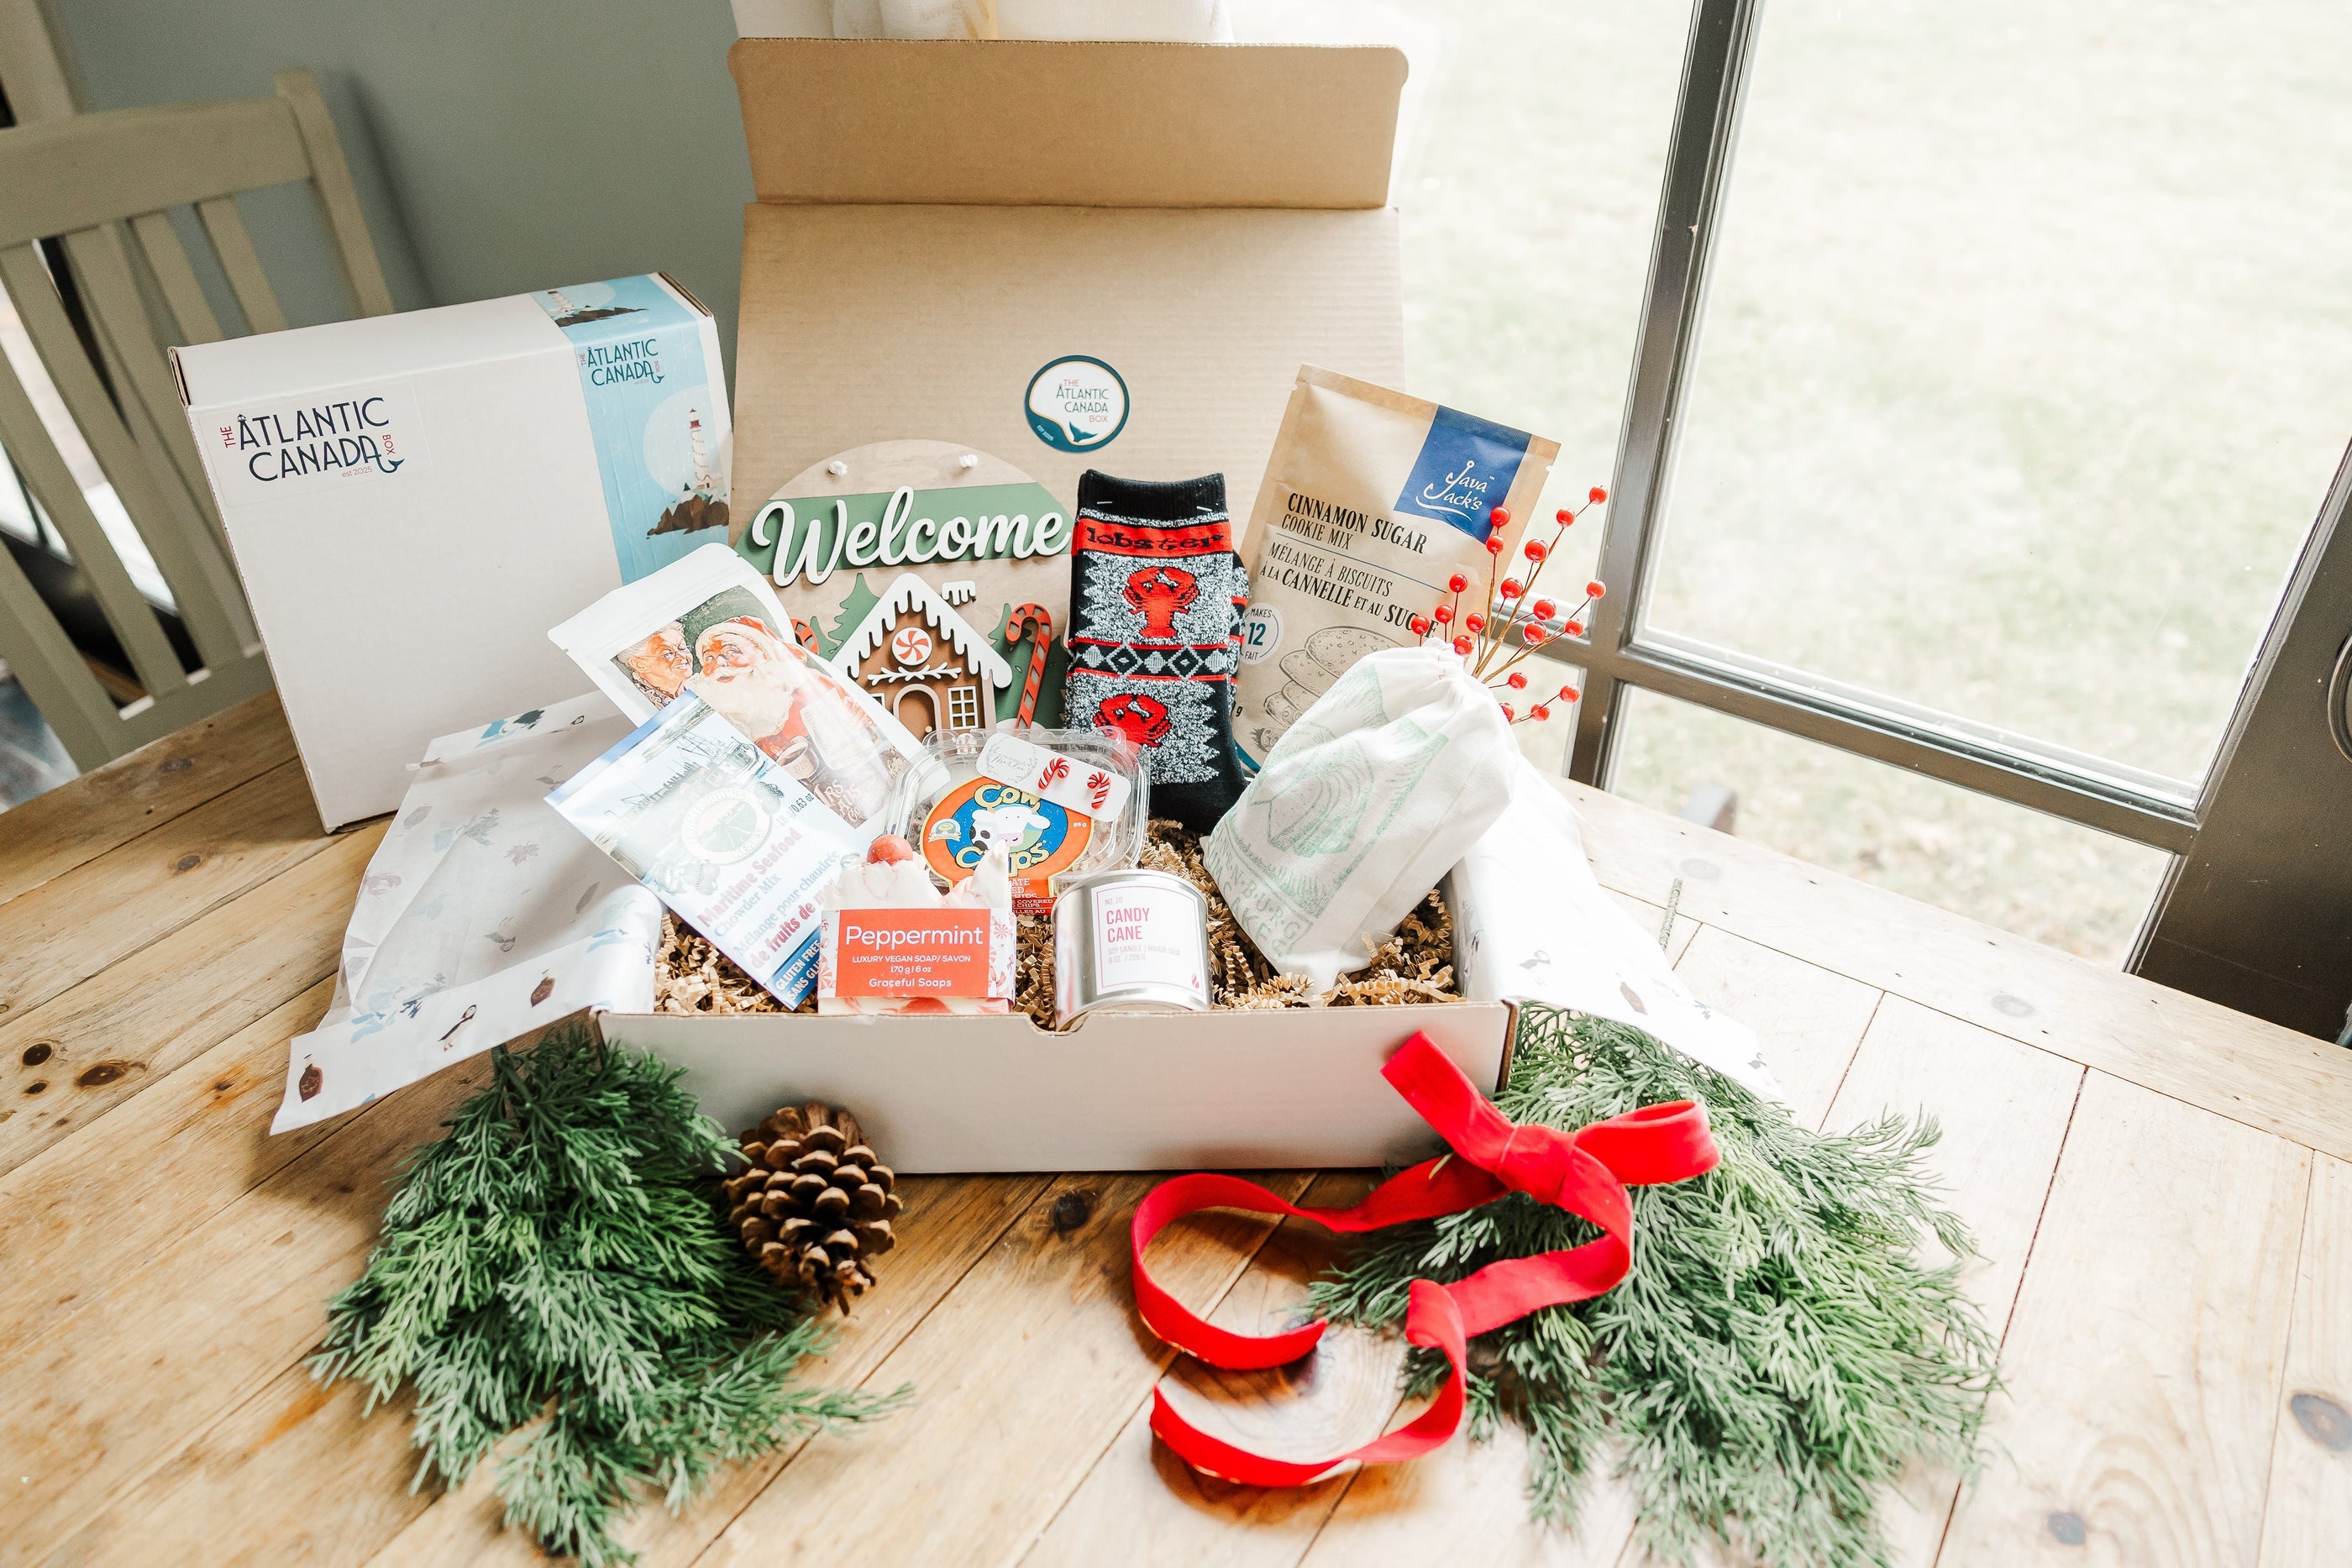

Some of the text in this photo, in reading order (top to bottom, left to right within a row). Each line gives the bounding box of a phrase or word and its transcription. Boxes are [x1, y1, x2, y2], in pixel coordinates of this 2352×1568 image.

[587, 338, 659, 367] ATLANTIC
[591, 360, 664, 385] CANADA
[1056, 385, 1109, 399] ATLANTIC
[1064, 401, 1109, 412] CANADA
[220, 426, 236, 448] THE
[239, 397, 389, 450] ATLANTIC
[249, 435, 405, 481] CANADA
[382, 434, 396, 455] BOX
[354, 466, 372, 475] 2025
[1445, 460, 1488, 493] Java
[1423, 483, 1483, 511] Jack's
[752, 485, 1072, 587] Welcome
[1281, 514, 1354, 550] COOKIE MIX
[1288, 492, 1427, 554] CINNAMON SUGAR
[1086, 527, 1225, 551] lobster
[1268, 542, 1393, 597] MÉLANGE À BISCUITS
[1250, 608, 1273, 618] MAKES
[1259, 561, 1439, 638] À LA CANNELLE ET AU SUCE
[1247, 622, 1267, 646] 12
[1244, 651, 1258, 661] FAIT
[696, 826, 803, 928] Maritime Seafood
[714, 873, 782, 937] Chowder Mix
[1106, 908, 1150, 925] CANDY
[733, 912, 779, 957] Mélange
[776, 889, 801, 917] pour
[750, 949, 770, 969] de
[764, 917, 801, 952] fruits
[798, 900, 816, 920] de
[1108, 926, 1142, 942] CANE
[846, 925, 984, 951] Peppermint
[775, 958, 806, 990] GLUTEN
[869, 978, 952, 989] Graceful Soaps
[788, 977, 809, 1000] SANS
